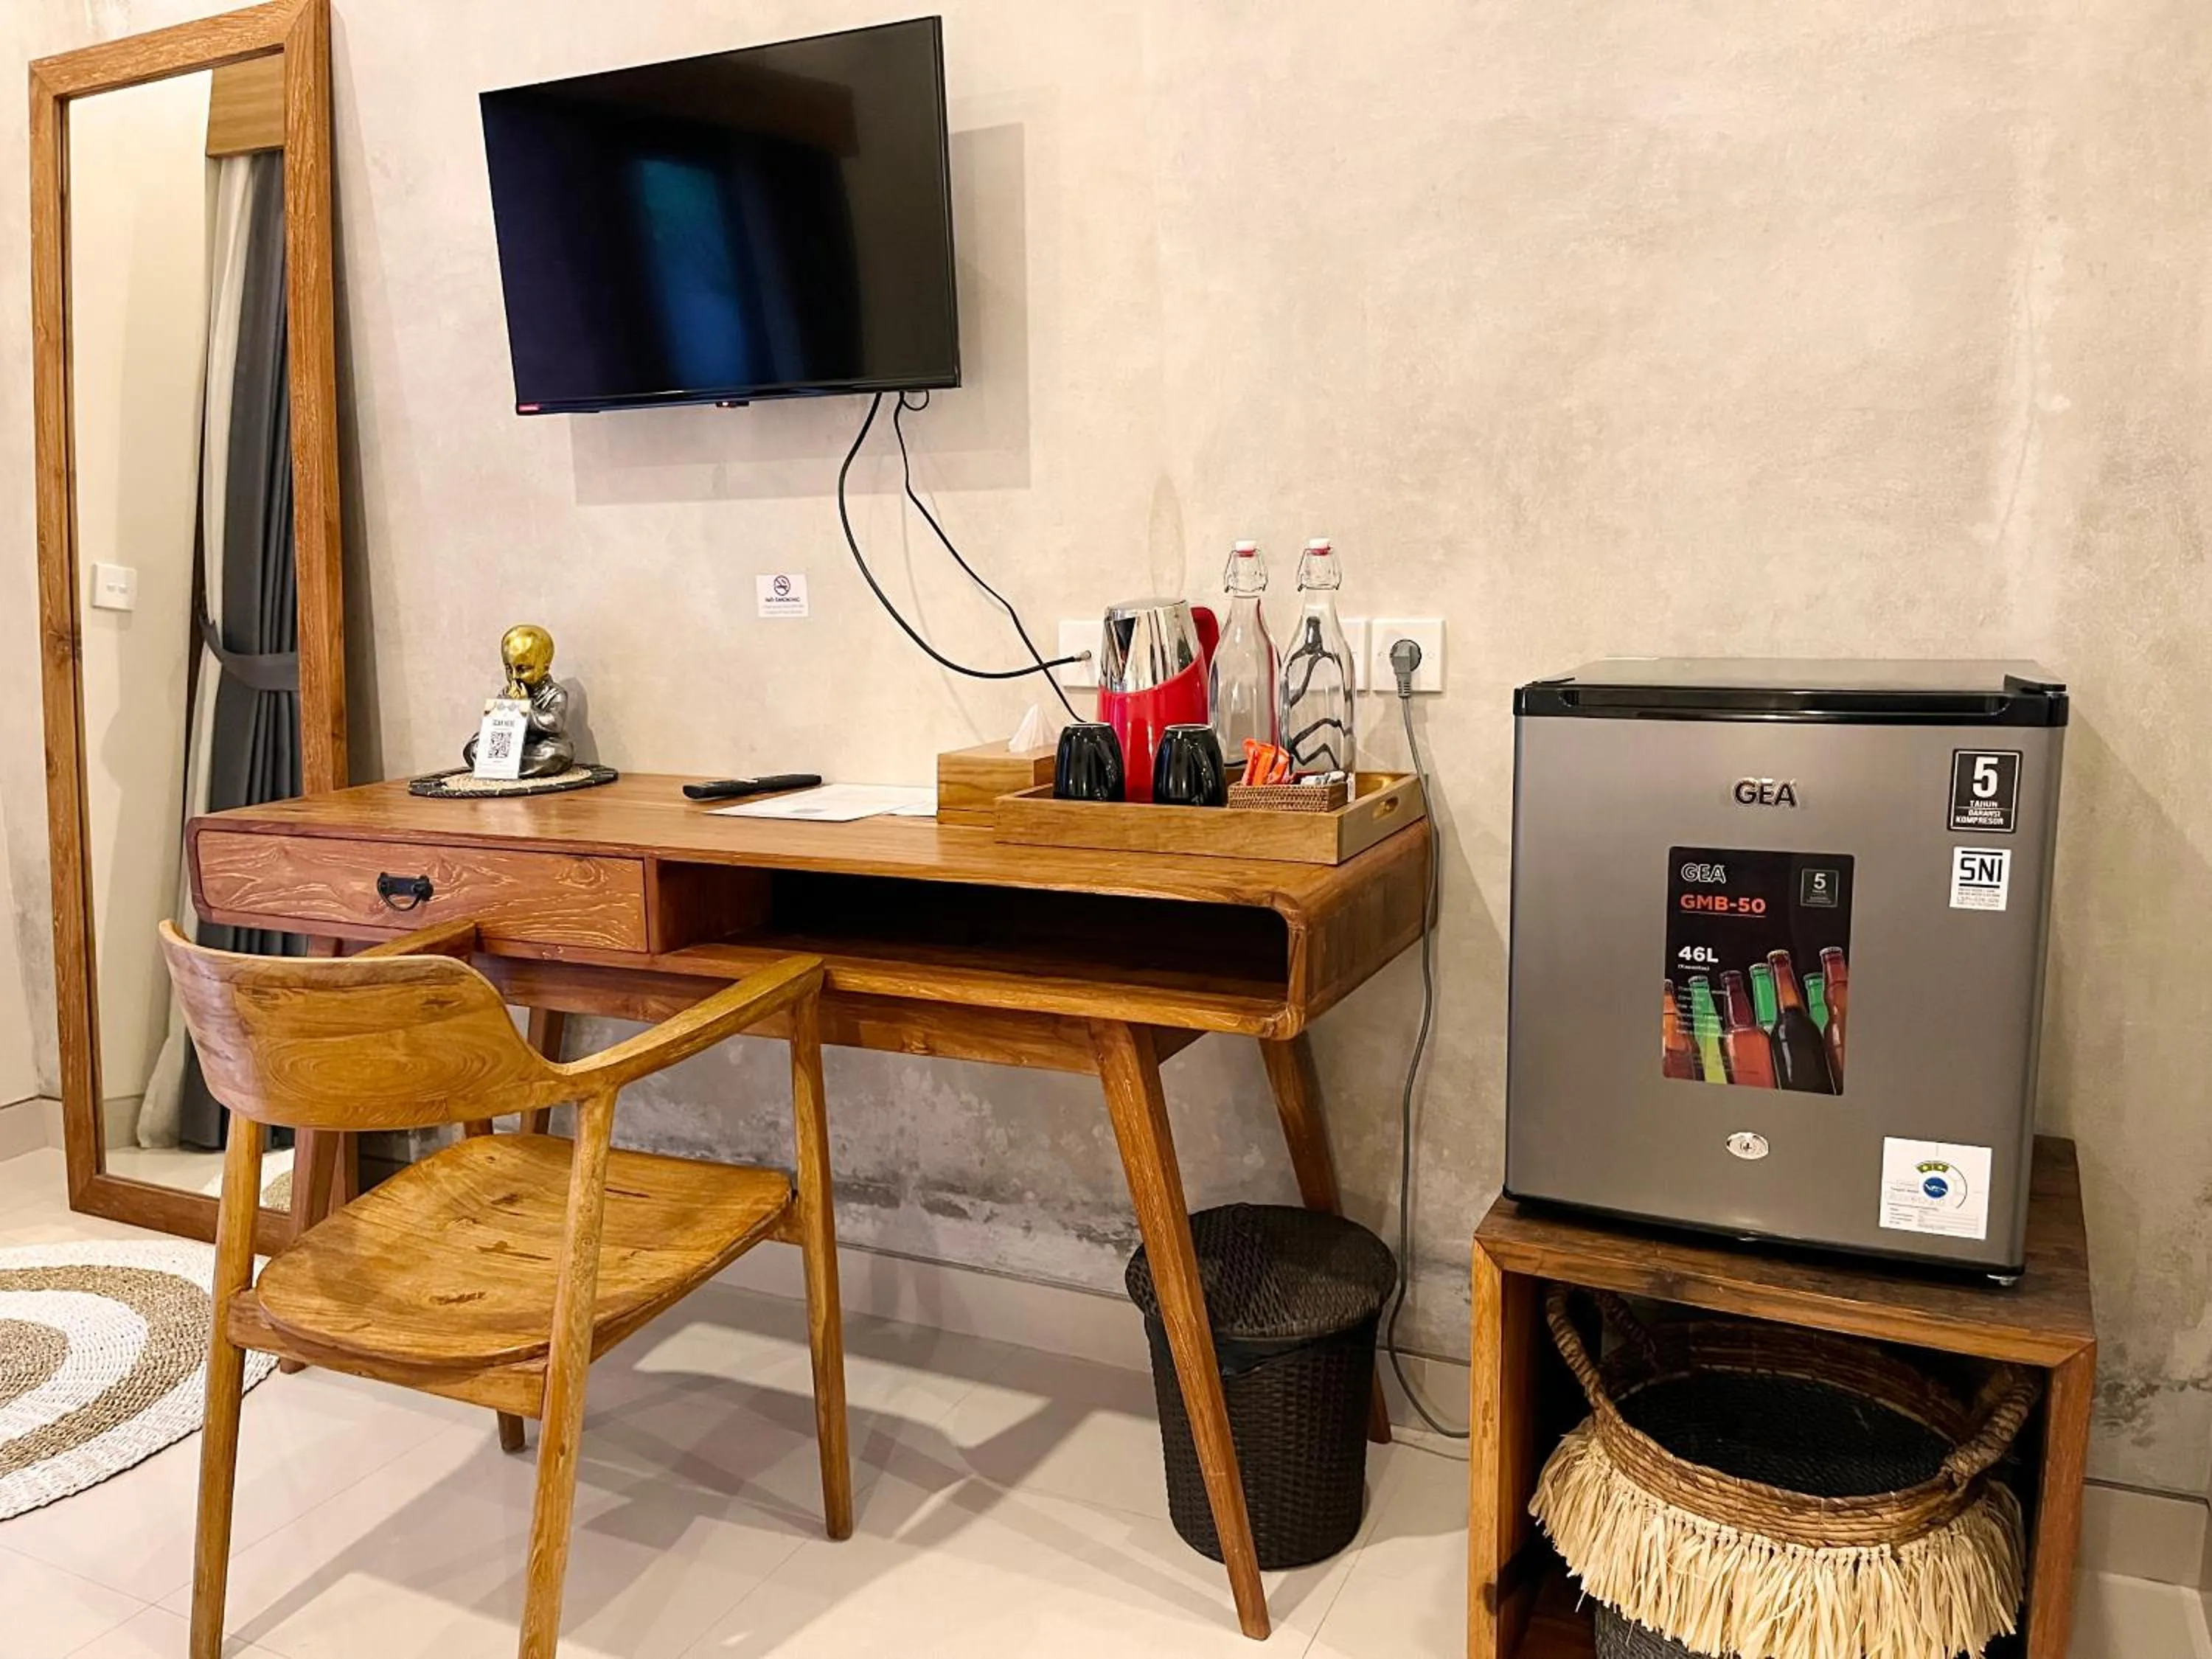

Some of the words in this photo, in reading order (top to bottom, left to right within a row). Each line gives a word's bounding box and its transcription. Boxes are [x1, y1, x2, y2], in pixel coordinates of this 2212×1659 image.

[1972, 757, 1998, 798] 5
[1733, 779, 1798, 808] GEA
[1969, 799, 1998, 807] TAHUN
[1955, 815, 2004, 825] KOMPRESOR
[1680, 862, 1727, 884] GEA
[1959, 857, 2003, 883] SNI
[1813, 872, 1826, 890] 5
[1680, 894, 1767, 914] GMB-50
[1677, 945, 1719, 963] 46L
